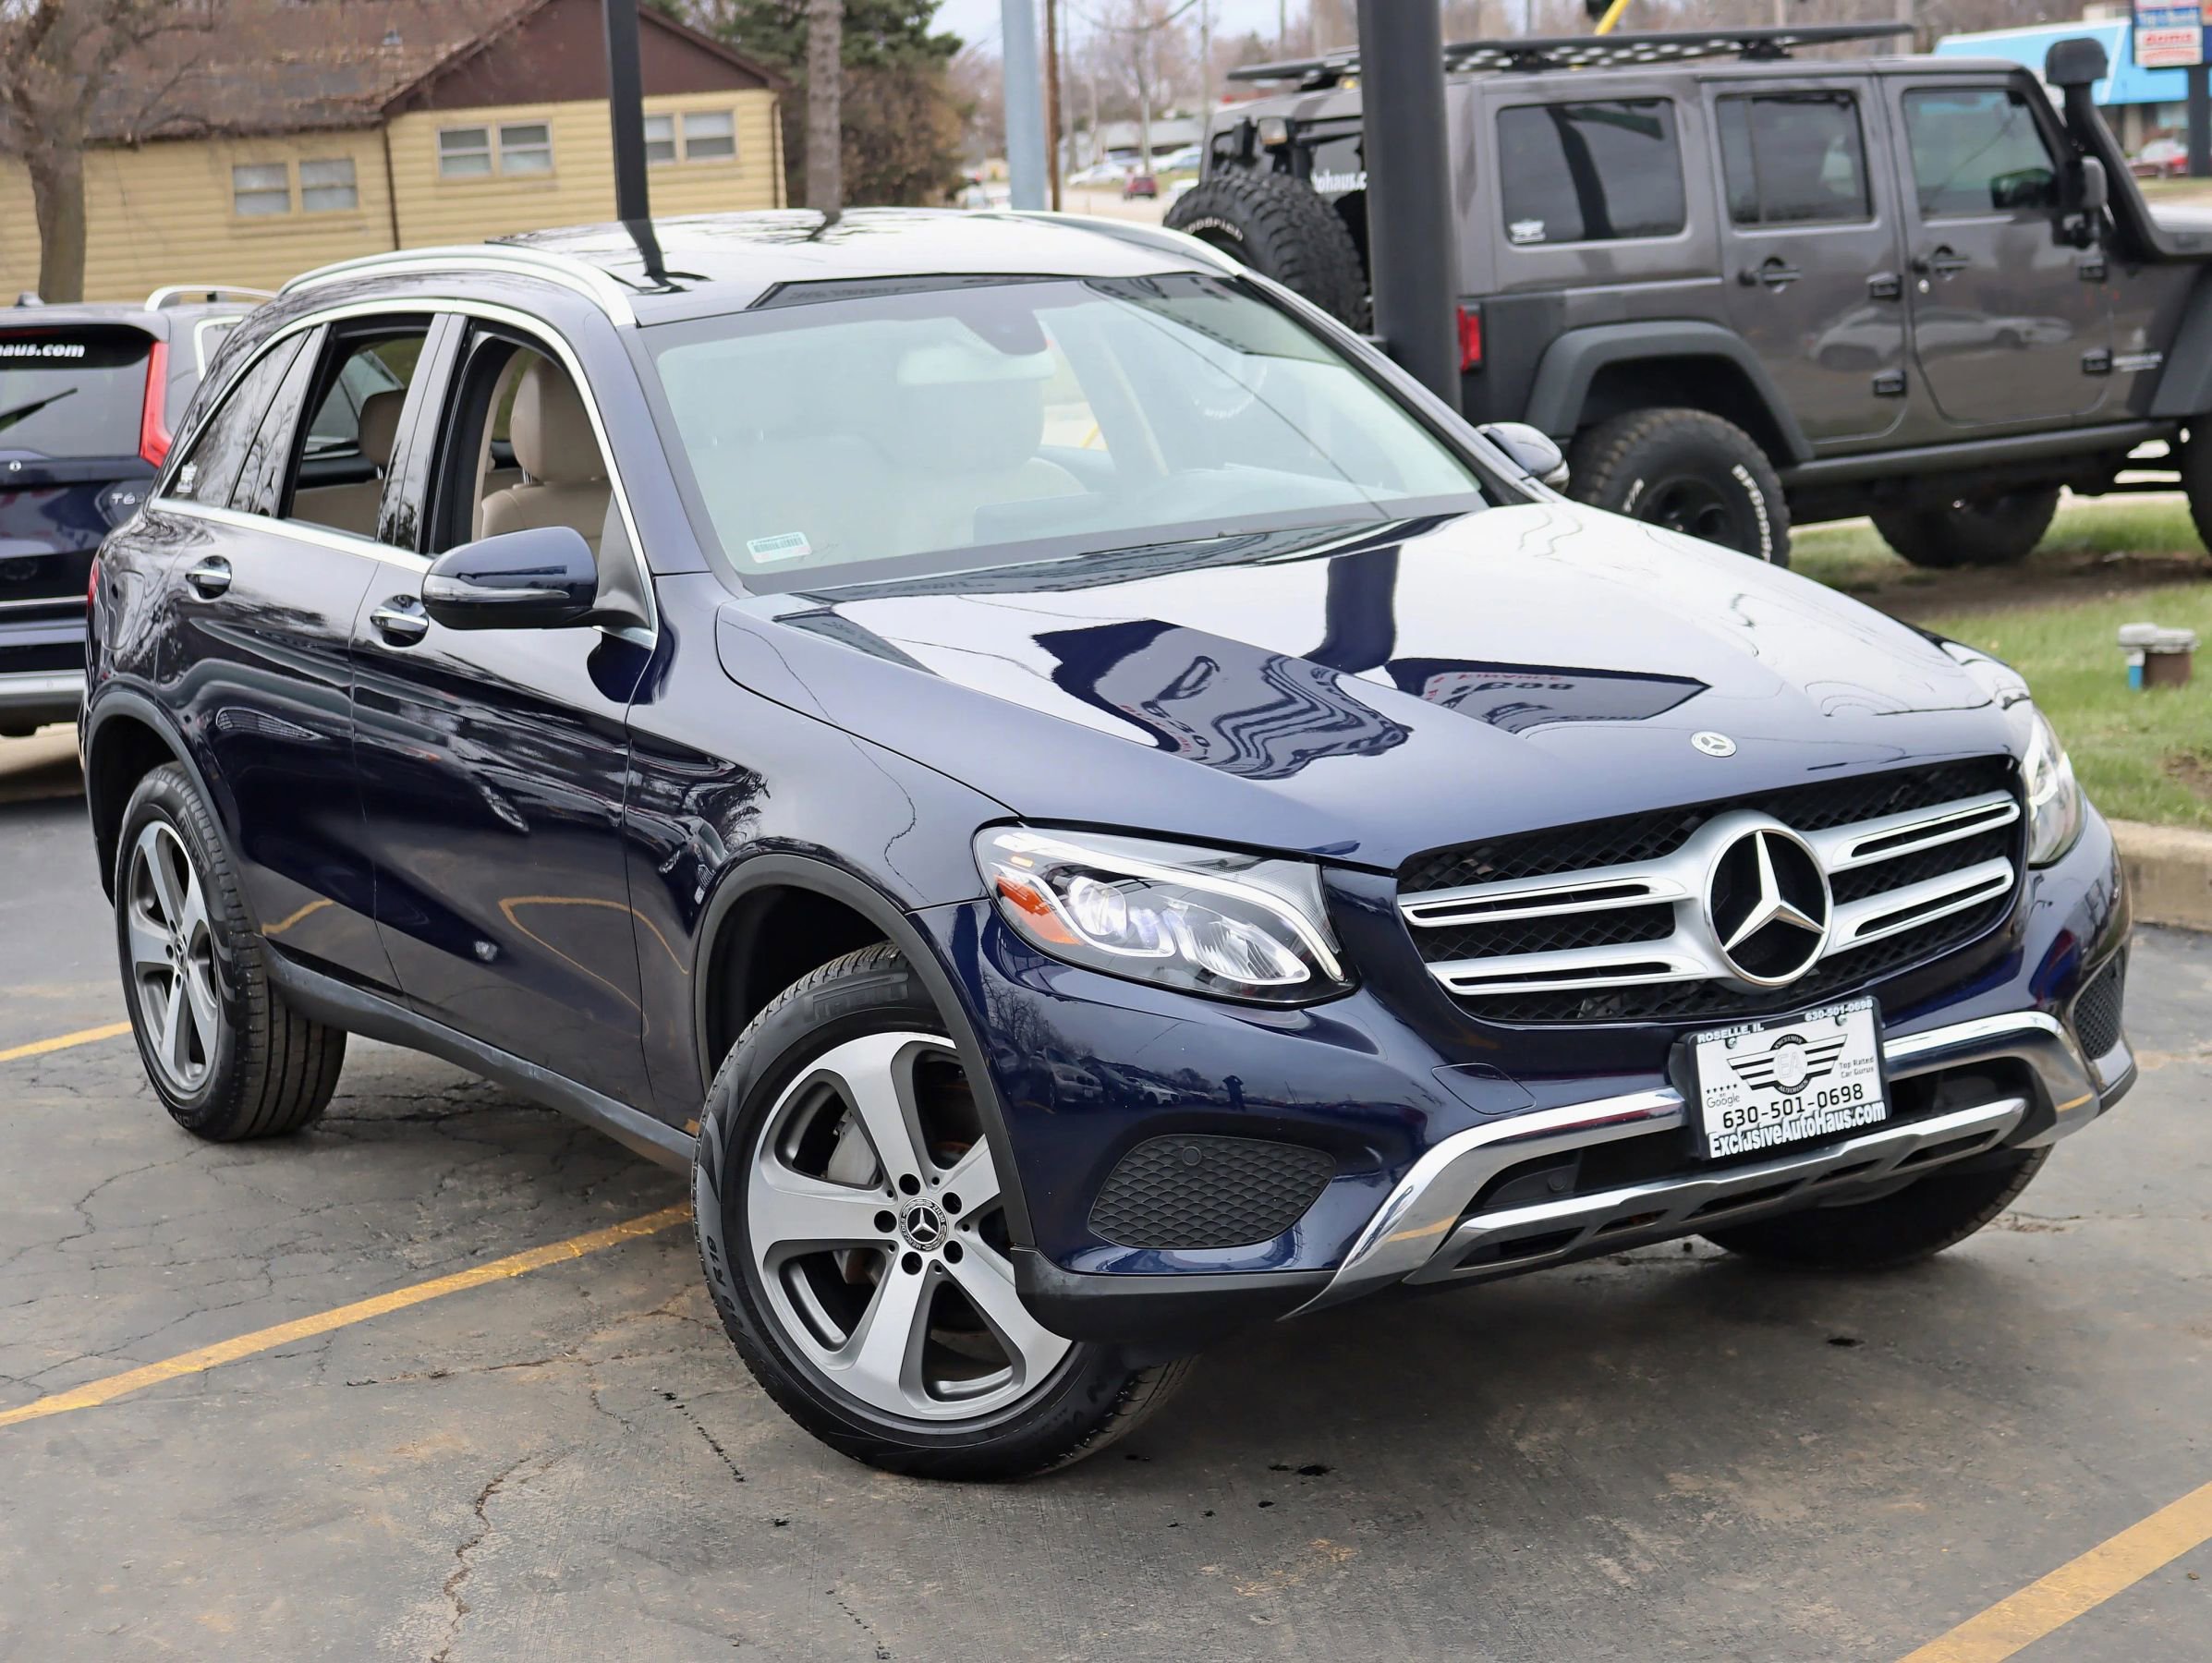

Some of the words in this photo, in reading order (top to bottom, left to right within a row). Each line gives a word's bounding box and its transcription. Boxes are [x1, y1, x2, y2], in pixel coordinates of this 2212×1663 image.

[1804, 999, 1873, 1022] 630-501-0698
[1696, 1026, 1752, 1044] ROSELLE,
[1753, 1022, 1765, 1034] IL
[1707, 1092, 1741, 1109] Google
[1723, 1083, 1865, 1129] 630-501-0698
[1709, 1100, 1887, 1159] ExclusiveAutoHaus.com
